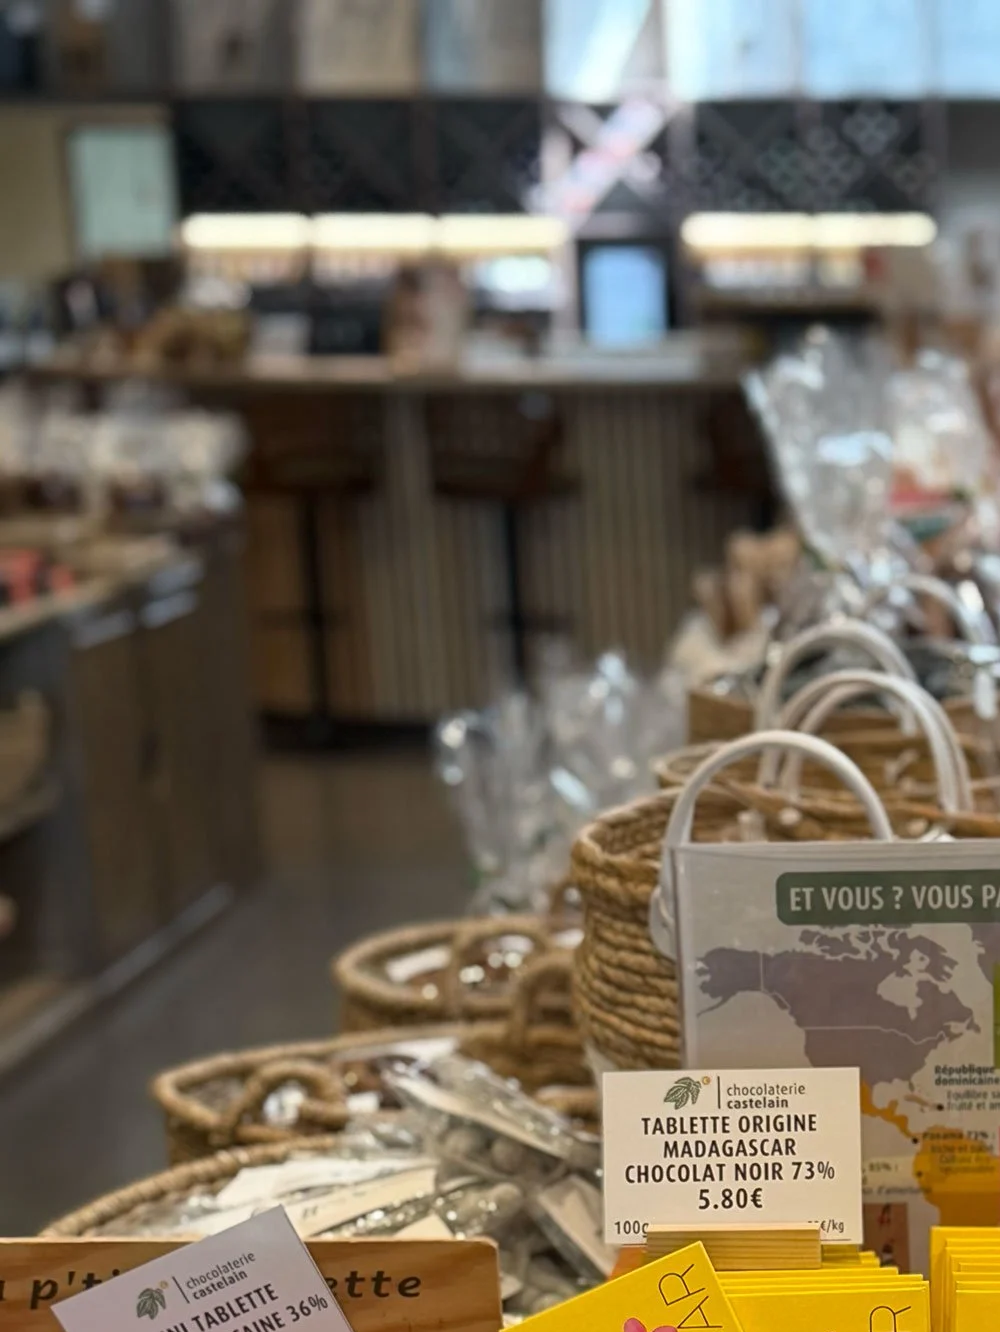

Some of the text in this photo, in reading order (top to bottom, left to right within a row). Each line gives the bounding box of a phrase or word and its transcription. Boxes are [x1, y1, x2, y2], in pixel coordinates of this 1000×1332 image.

[789, 887, 814, 911] ET
[821, 885, 884, 910] VOUS
[892, 885, 903, 909] ?
[911, 883, 973, 909] VOUS
[934, 1064, 996, 1077] République
[934, 1075, 1000, 1086] dominicaine
[727, 1083, 806, 1098] chocolaterie
[727, 1098, 789, 1110] castelain
[641, 1113, 818, 1136] TABLETTE ORIGINE
[663, 1138, 797, 1159] MADAGASCAR
[625, 1160, 836, 1184] CHOCOLAT NOIR 73%
[698, 1187, 764, 1211] 5.80€
[614, 1220, 649, 1238] 100g
[186, 1251, 256, 1291] chocolaterie
[192, 1269, 248, 1301] castelain
[191, 1283, 279, 1332] TABLETTE
[286, 1294, 329, 1323] 36%
